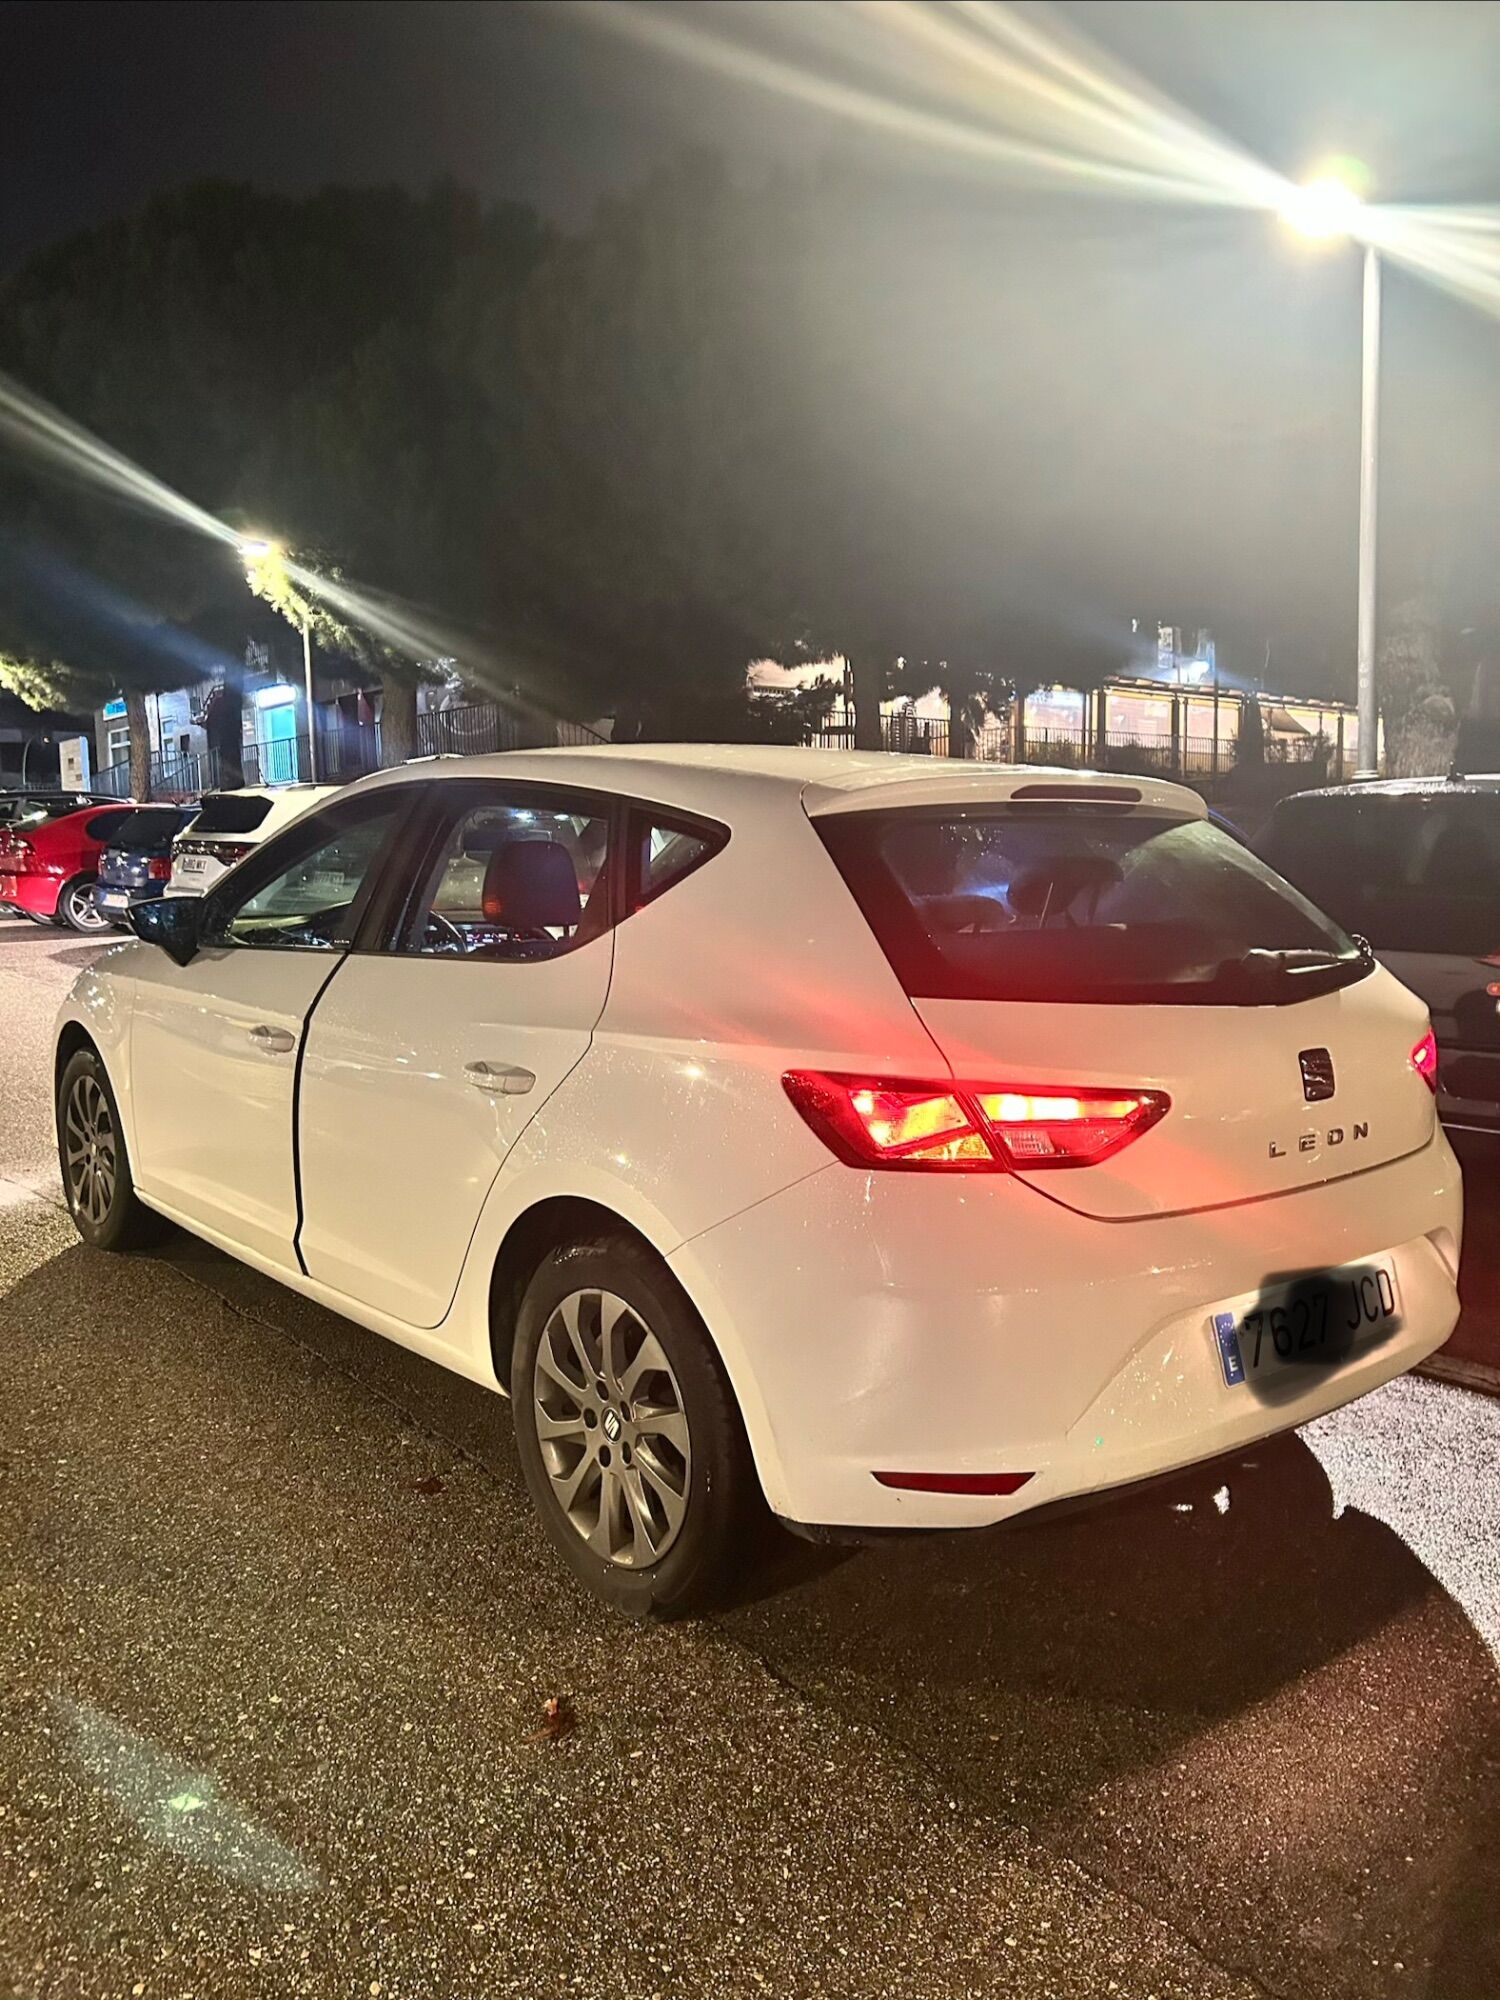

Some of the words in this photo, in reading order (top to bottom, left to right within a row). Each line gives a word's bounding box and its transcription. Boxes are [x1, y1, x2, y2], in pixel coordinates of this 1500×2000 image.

[1269, 1122, 1369, 1158] LEON
[1228, 1355, 1239, 1373] E
[1243, 1291, 1329, 1369] 7627
[1347, 1268, 1395, 1331] JCD
